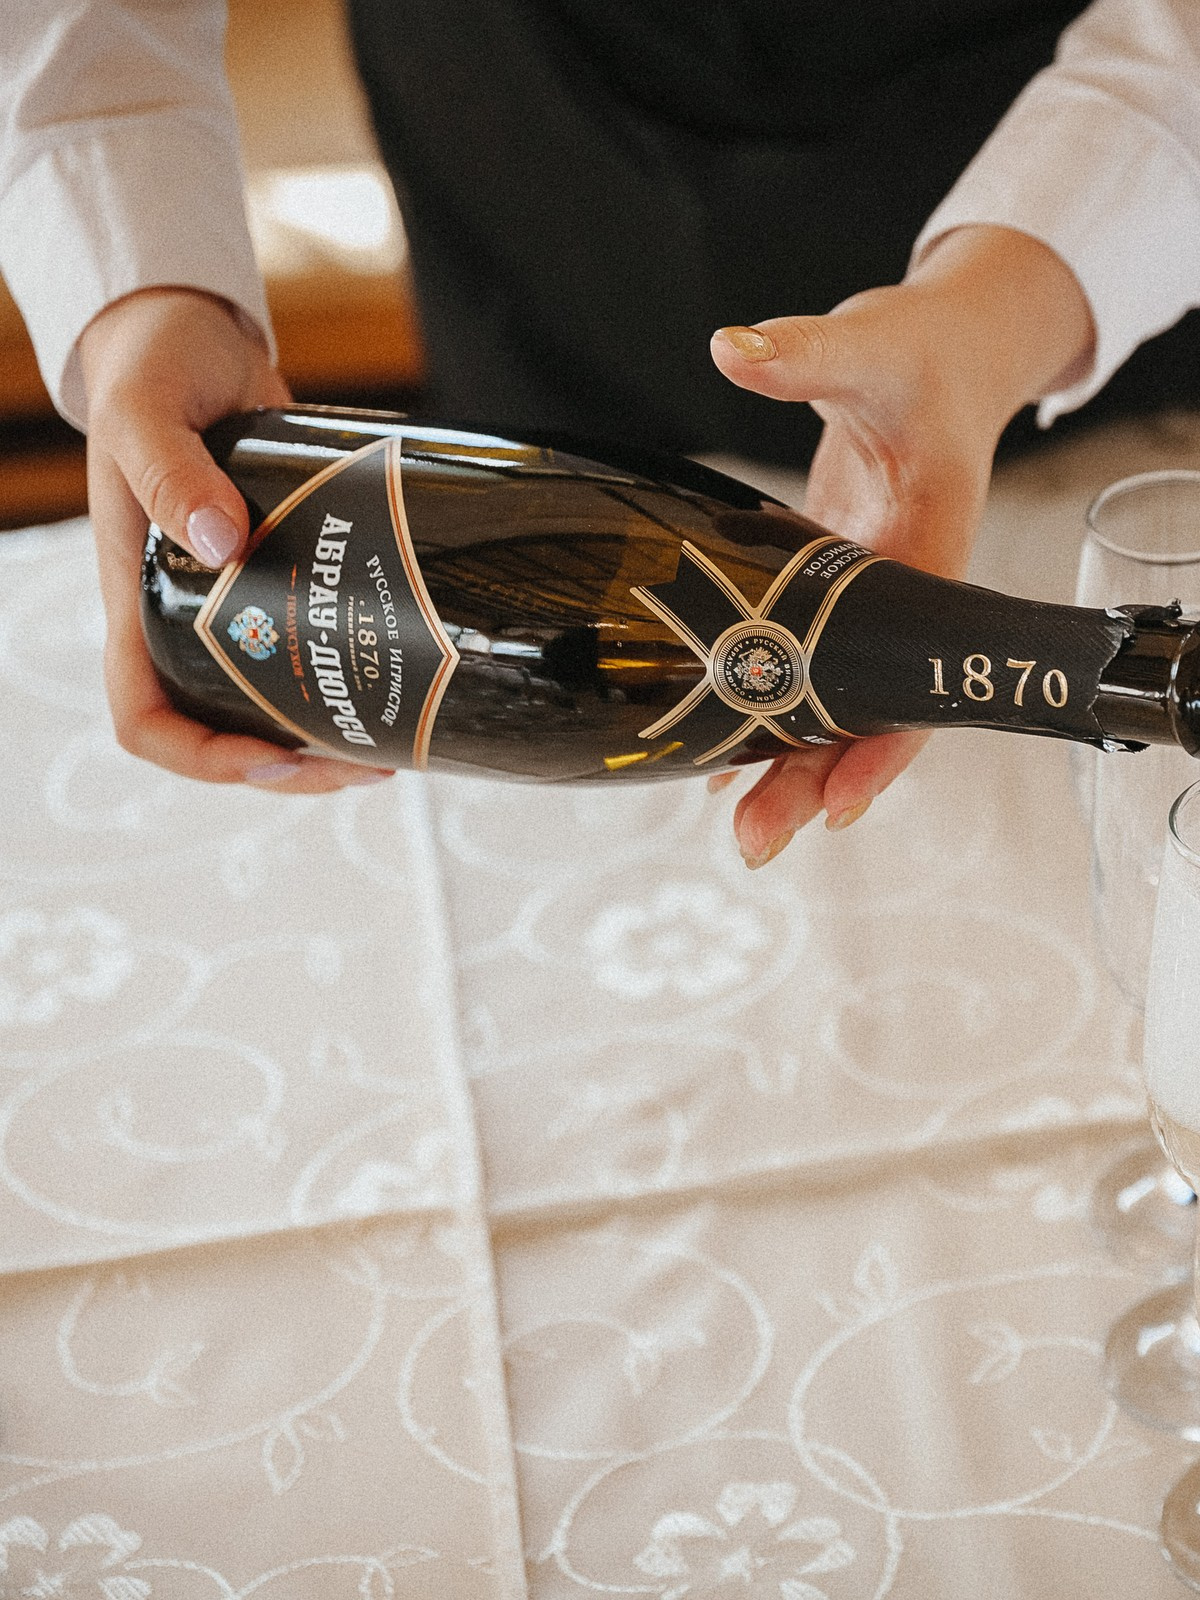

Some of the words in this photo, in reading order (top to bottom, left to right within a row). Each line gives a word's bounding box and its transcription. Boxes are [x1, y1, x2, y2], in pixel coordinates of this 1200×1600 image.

[307, 513, 377, 748] АБРАУ-ДЮРСО
[366, 554, 400, 641] РУССКОЕ
[357, 612, 380, 680] 1870
[753, 638, 788, 661] РУССКИЙ
[928, 653, 1068, 708] 1870
[381, 647, 404, 727] ИГРИСТОЕ
